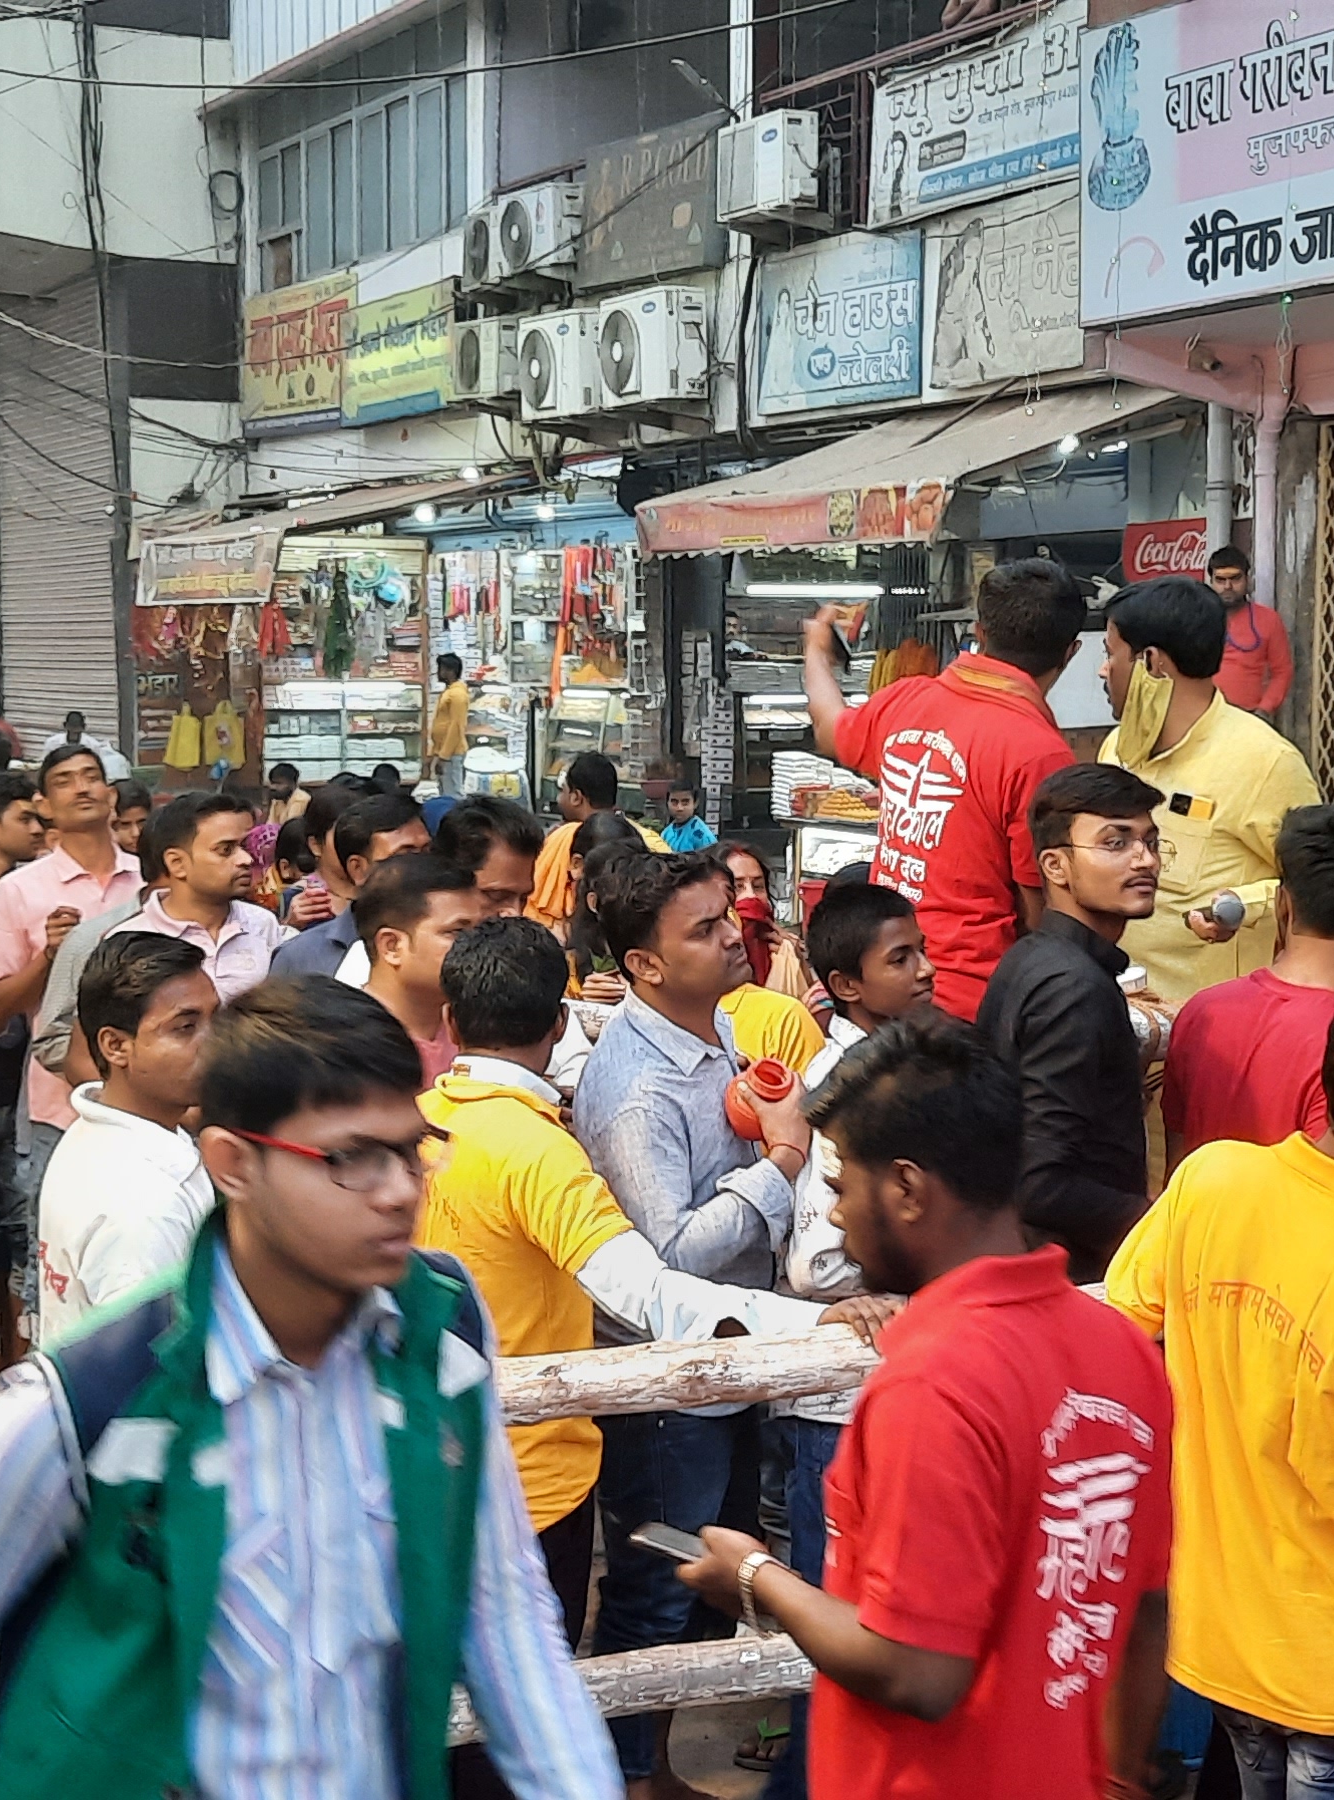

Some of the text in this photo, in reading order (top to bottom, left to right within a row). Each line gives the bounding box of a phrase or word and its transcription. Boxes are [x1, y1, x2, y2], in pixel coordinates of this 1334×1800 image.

[1165, 58, 1234, 133] बाबा
[1185, 209, 1283, 287] दैनिक
[843, 279, 918, 338] हाउस
